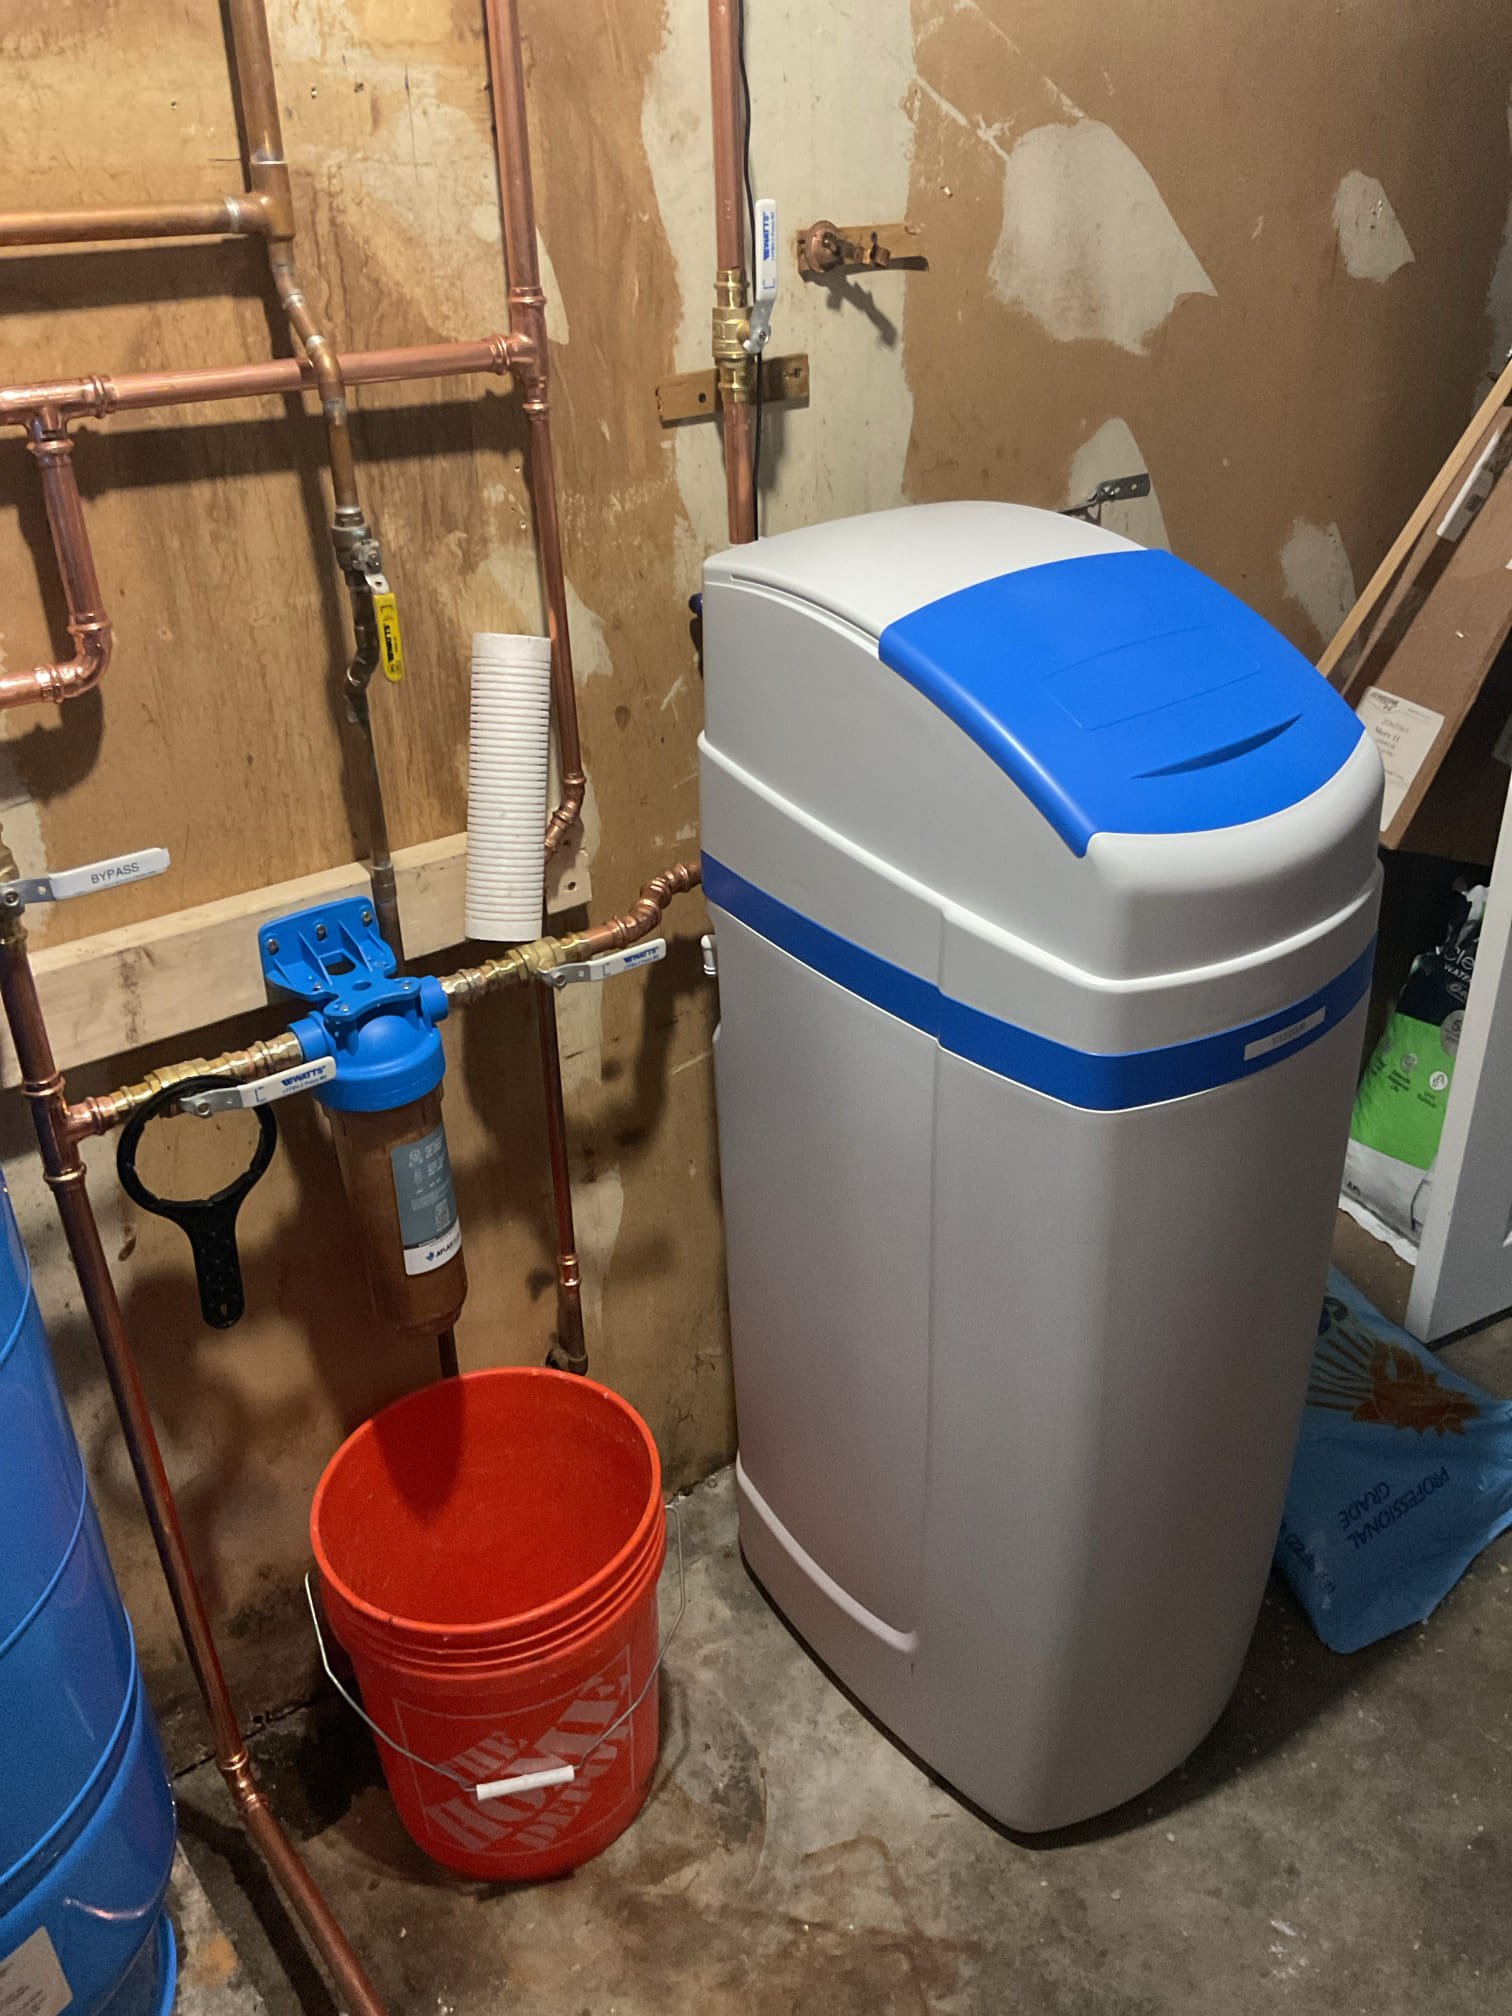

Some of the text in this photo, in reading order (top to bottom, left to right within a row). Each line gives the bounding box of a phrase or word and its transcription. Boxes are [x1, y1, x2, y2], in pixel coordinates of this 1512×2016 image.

[91, 862, 140, 884] BYPASS
[623, 946, 658, 963] WATTS
[281, 1066, 325, 1087] WATTS
[1339, 1481, 1391, 1531] GRADE
[1346, 1466, 1450, 1549] PROFESSIONAL
